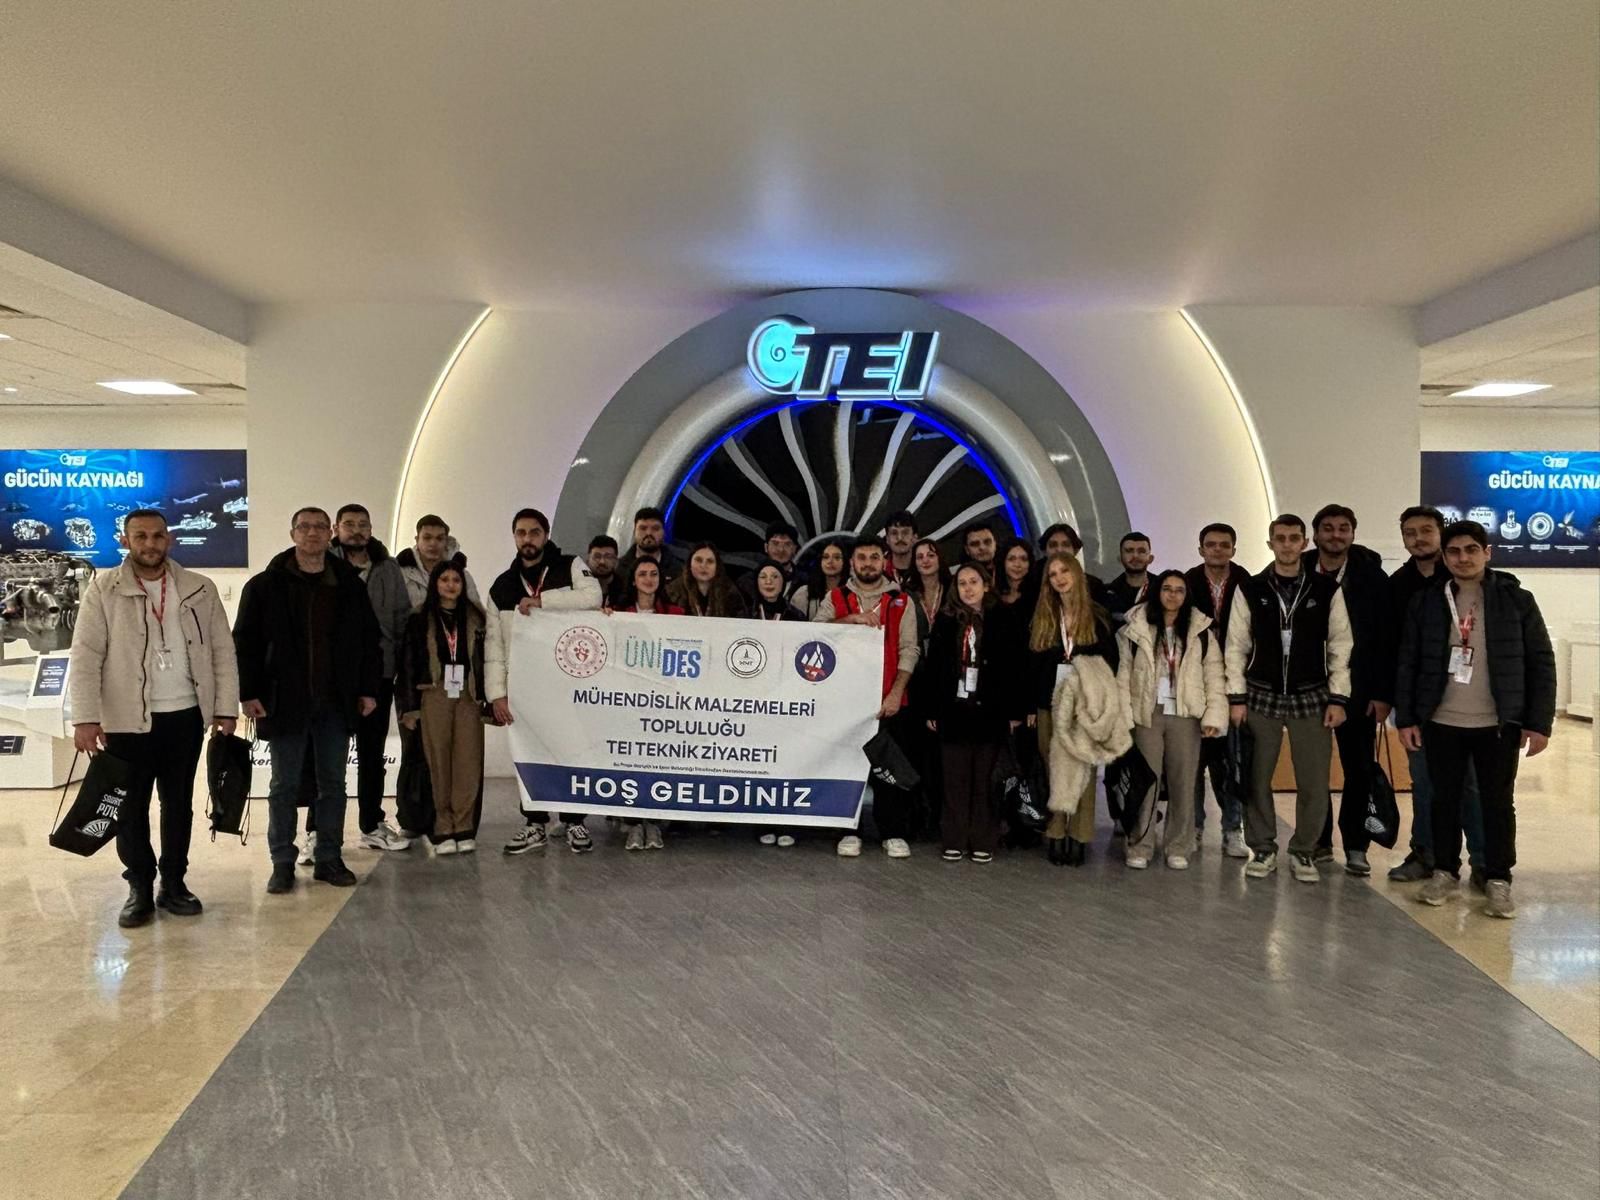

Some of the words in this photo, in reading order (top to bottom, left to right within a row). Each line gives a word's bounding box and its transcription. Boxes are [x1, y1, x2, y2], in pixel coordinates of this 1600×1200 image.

[790, 329, 940, 401] TEI
[4, 469, 62, 487] GÜCÜN
[66, 471, 144, 487] KAYNAĞI
[1488, 470, 1545, 489] GÜCÜN
[573, 686, 692, 711] MÜHENDİSLİK
[694, 697, 815, 717] MALZEMELERİ
[639, 718, 745, 737] TOPLULUĞU
[606, 740, 632, 756] TEI
[635, 740, 698, 759] TEKNİK
[701, 742, 777, 763] ZİYARETİ
[571, 775, 639, 805] HOŞ
[650, 780, 812, 808] GELDİNİZ
